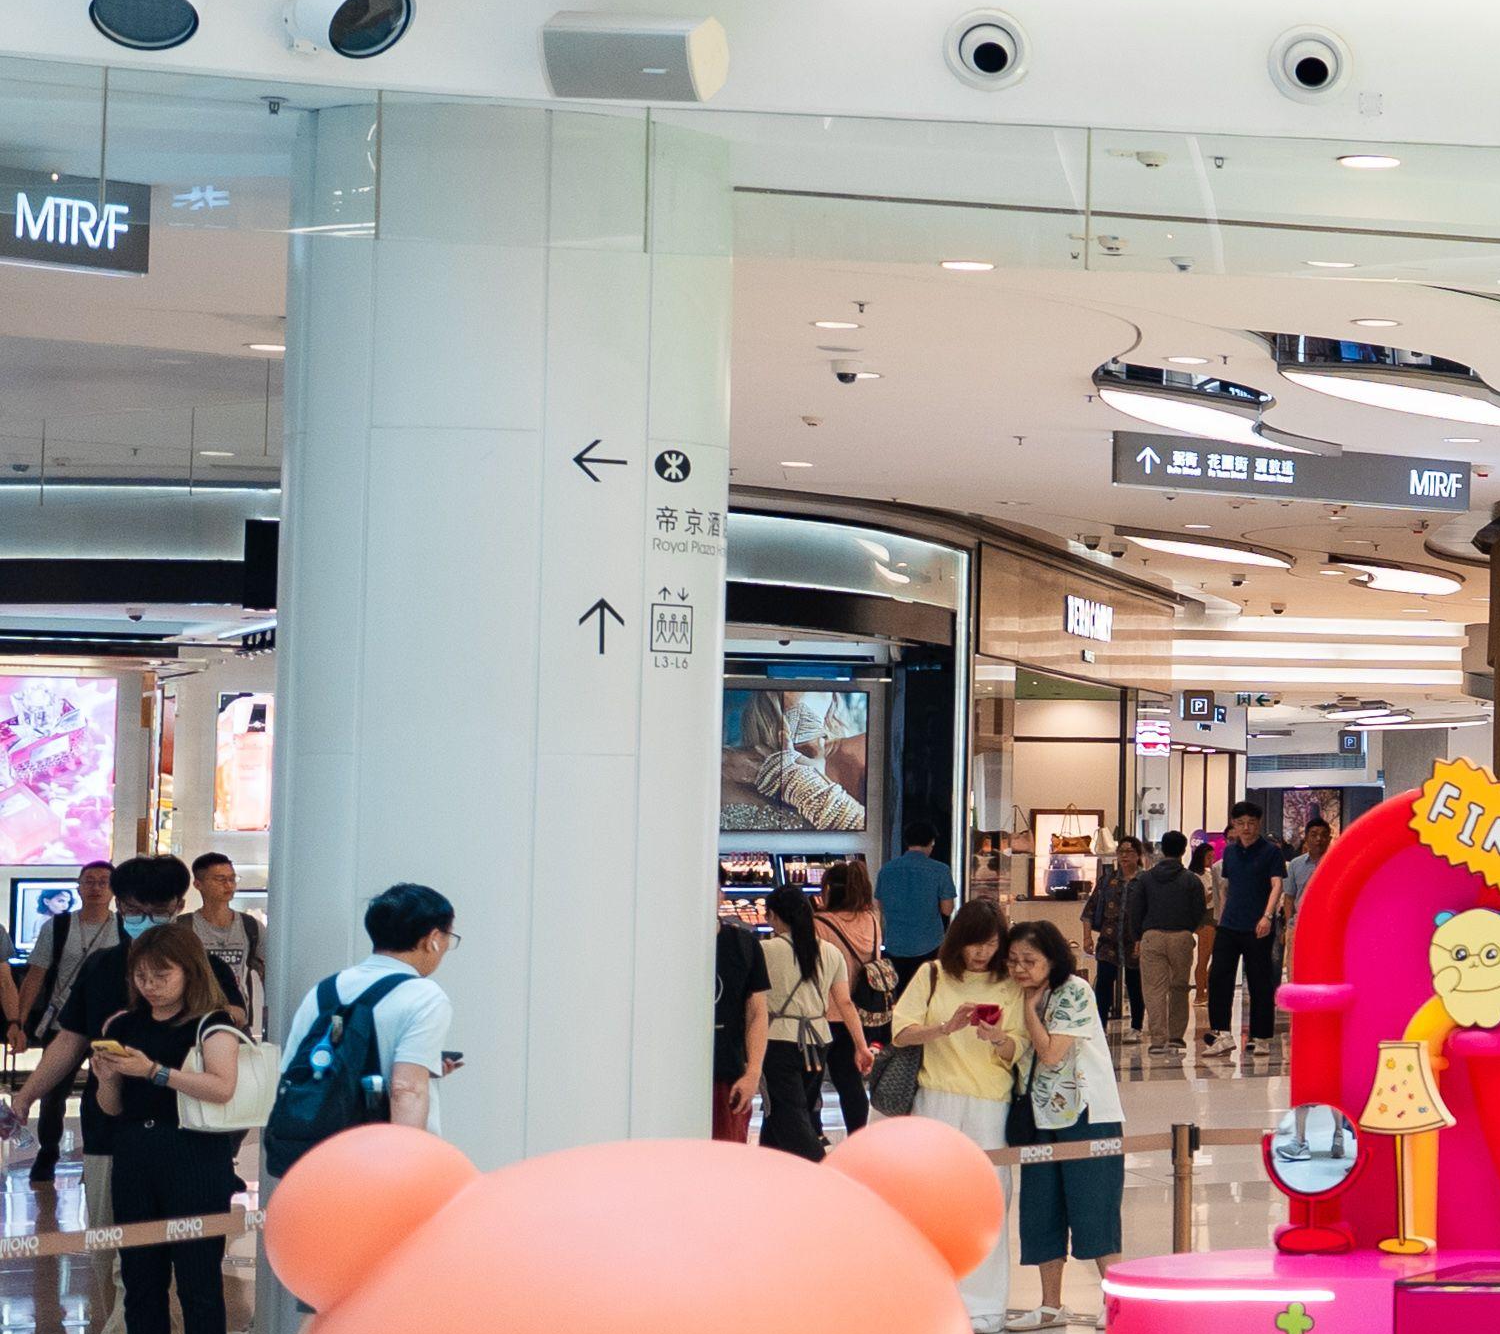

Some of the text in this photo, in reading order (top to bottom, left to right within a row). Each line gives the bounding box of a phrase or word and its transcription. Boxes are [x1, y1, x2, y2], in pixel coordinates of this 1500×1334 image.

[656, 506, 727, 538] 帝京酒
[652, 537, 689, 555] Royal
[654, 655, 689, 669] L3-L6
[167, 1217, 204, 1235] MOKO
[85, 1227, 124, 1245] MOKO
